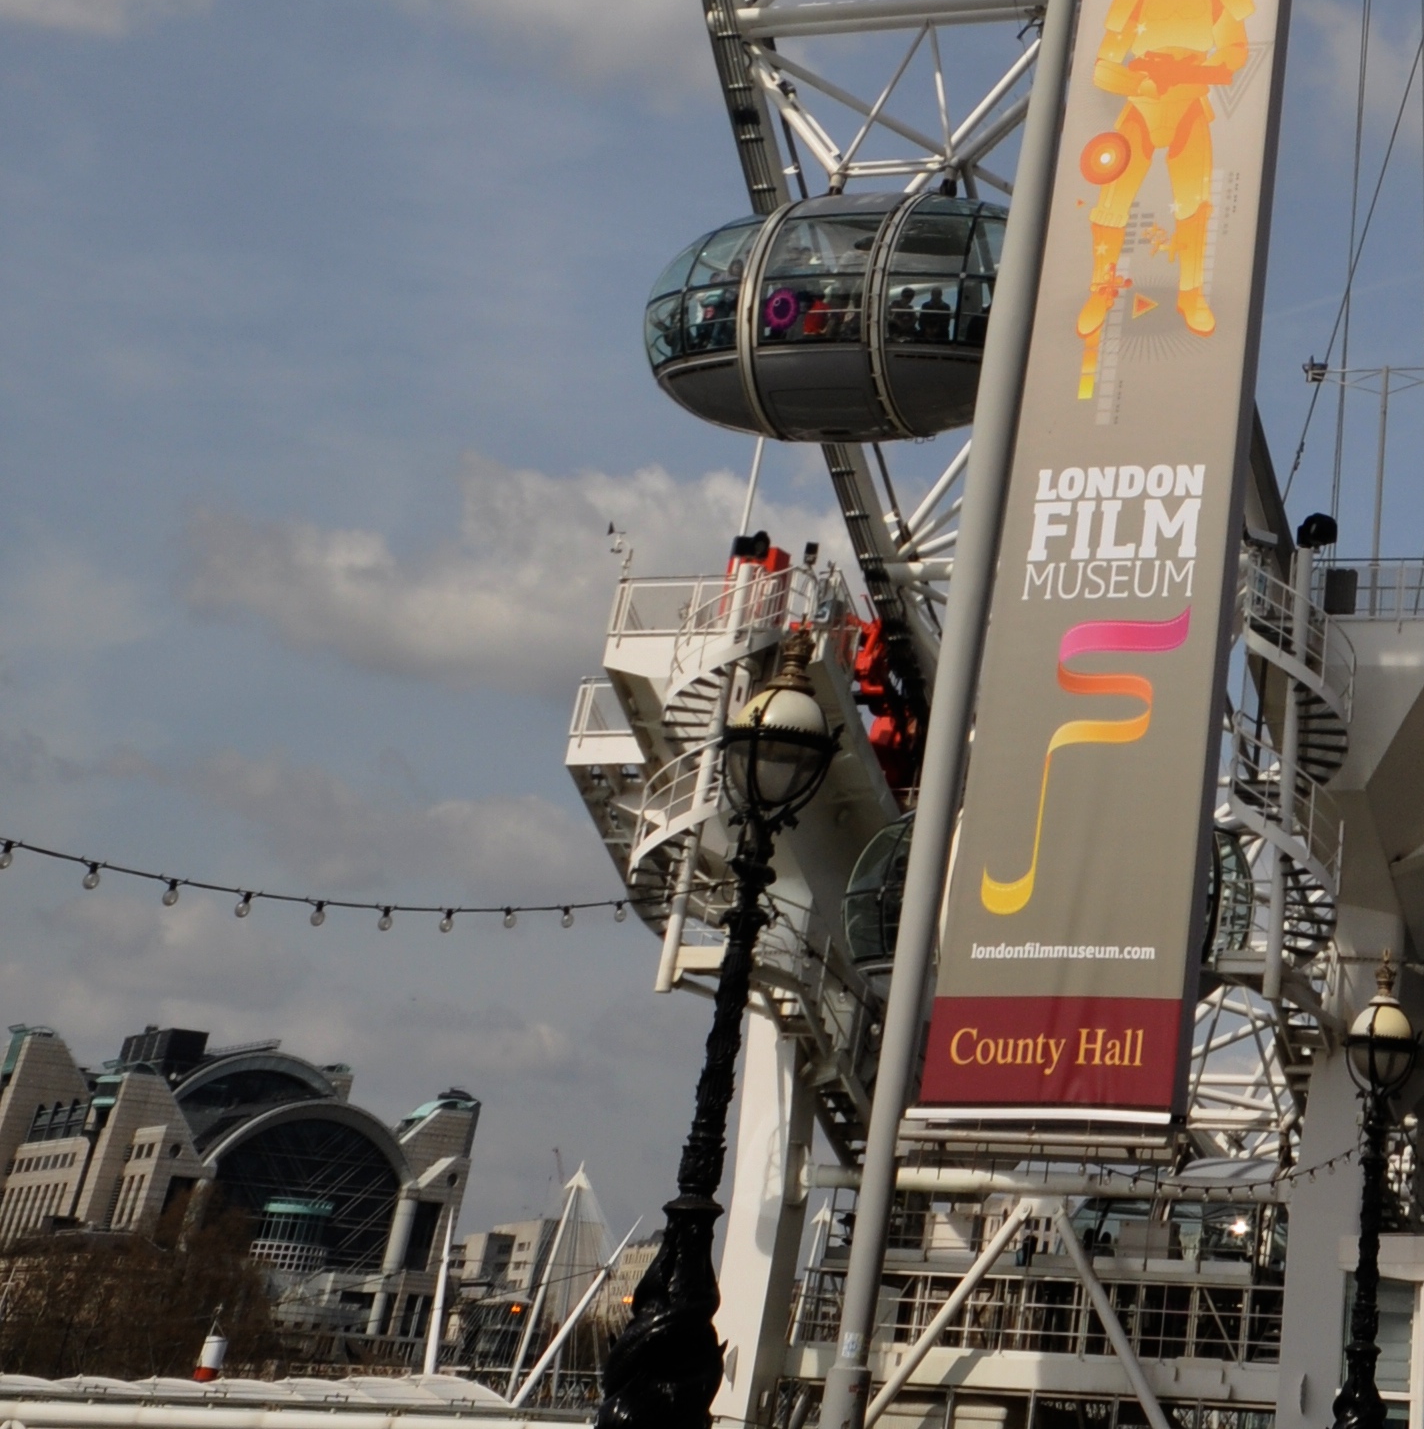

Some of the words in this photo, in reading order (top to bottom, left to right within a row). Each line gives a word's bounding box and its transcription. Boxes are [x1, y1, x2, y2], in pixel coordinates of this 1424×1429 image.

[1035, 464, 1206, 501] LONDON
[1027, 498, 1202, 561] FILM
[1021, 559, 1195, 600] MUSEUM
[970, 942, 1155, 960] londonfilmmuseum.com
[950, 1027, 1066, 1075] County
[1075, 1028, 1144, 1066] Hall
